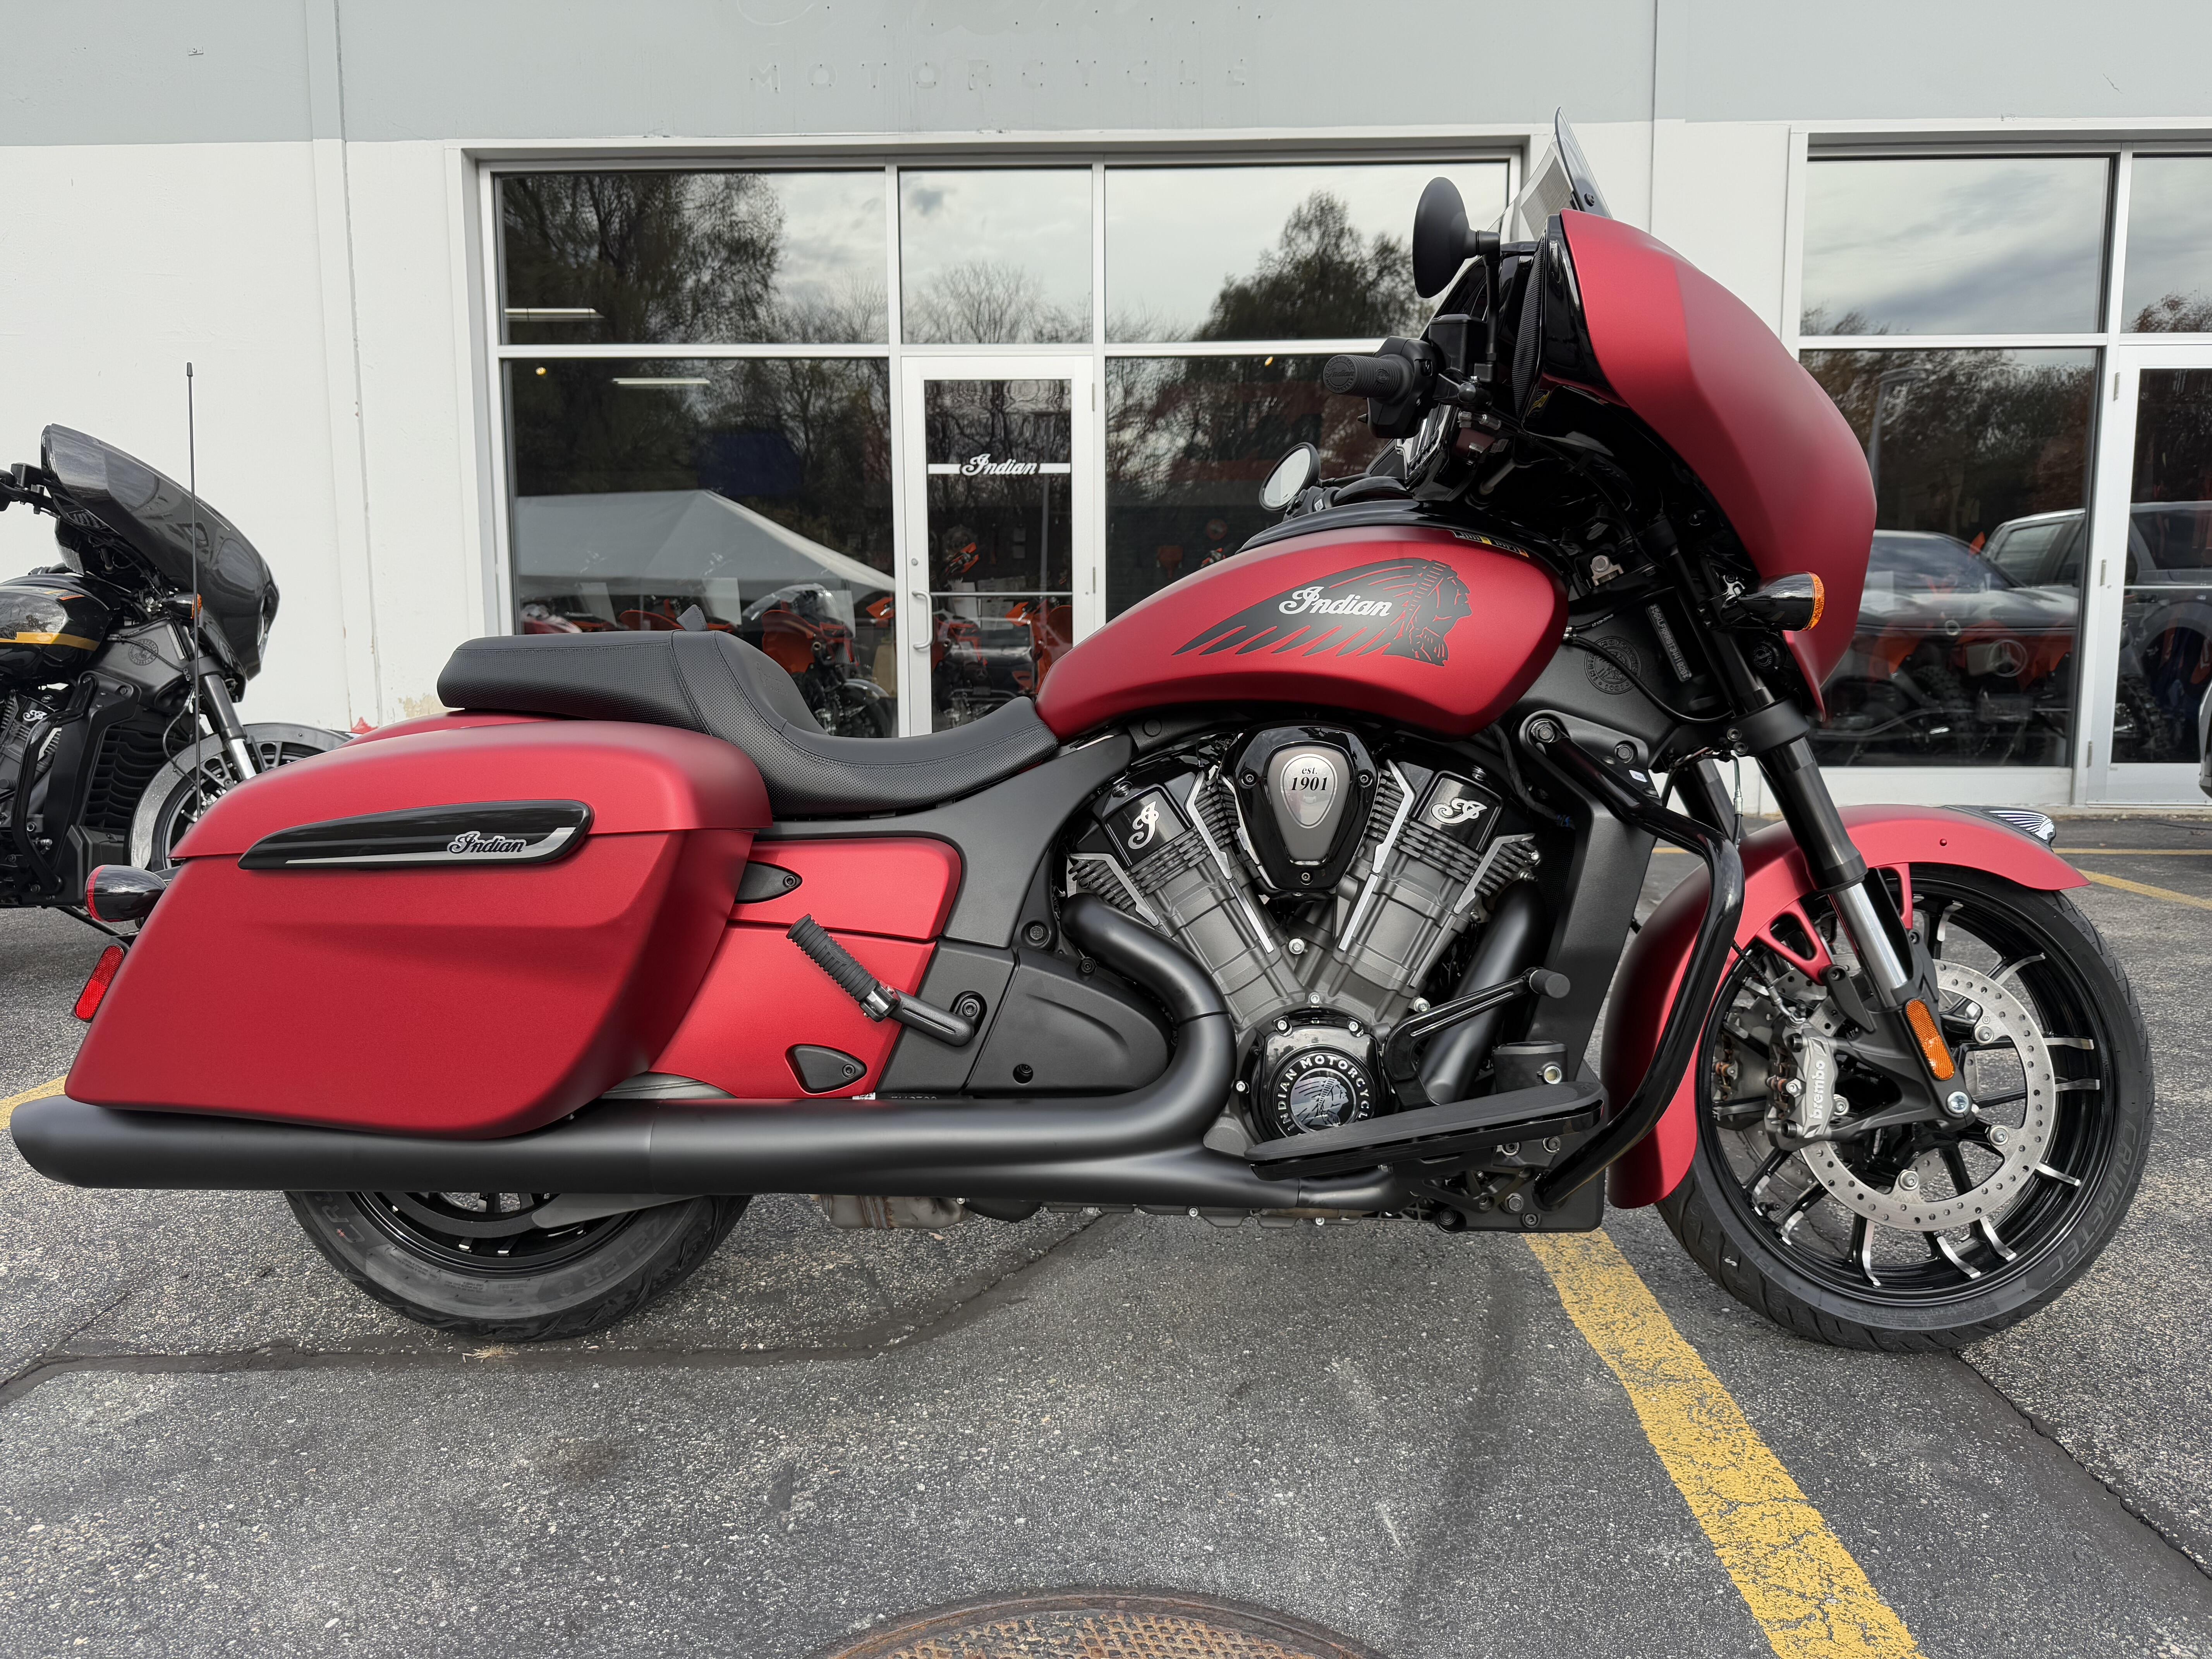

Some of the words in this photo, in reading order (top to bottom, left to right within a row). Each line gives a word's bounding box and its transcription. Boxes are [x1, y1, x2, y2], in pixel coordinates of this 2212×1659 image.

[962, 453, 1037, 476] Indian
[1279, 586, 1393, 617] Indian
[1290, 776, 1328, 791] 1901
[448, 832, 526, 854] Indian
[1278, 1068, 1297, 1131] INDIAN
[1300, 1055, 1369, 1118] MOTORCYCL
[1809, 1060, 1825, 1119] brembo
[2047, 1119, 2136, 1278] CRUISETEC
